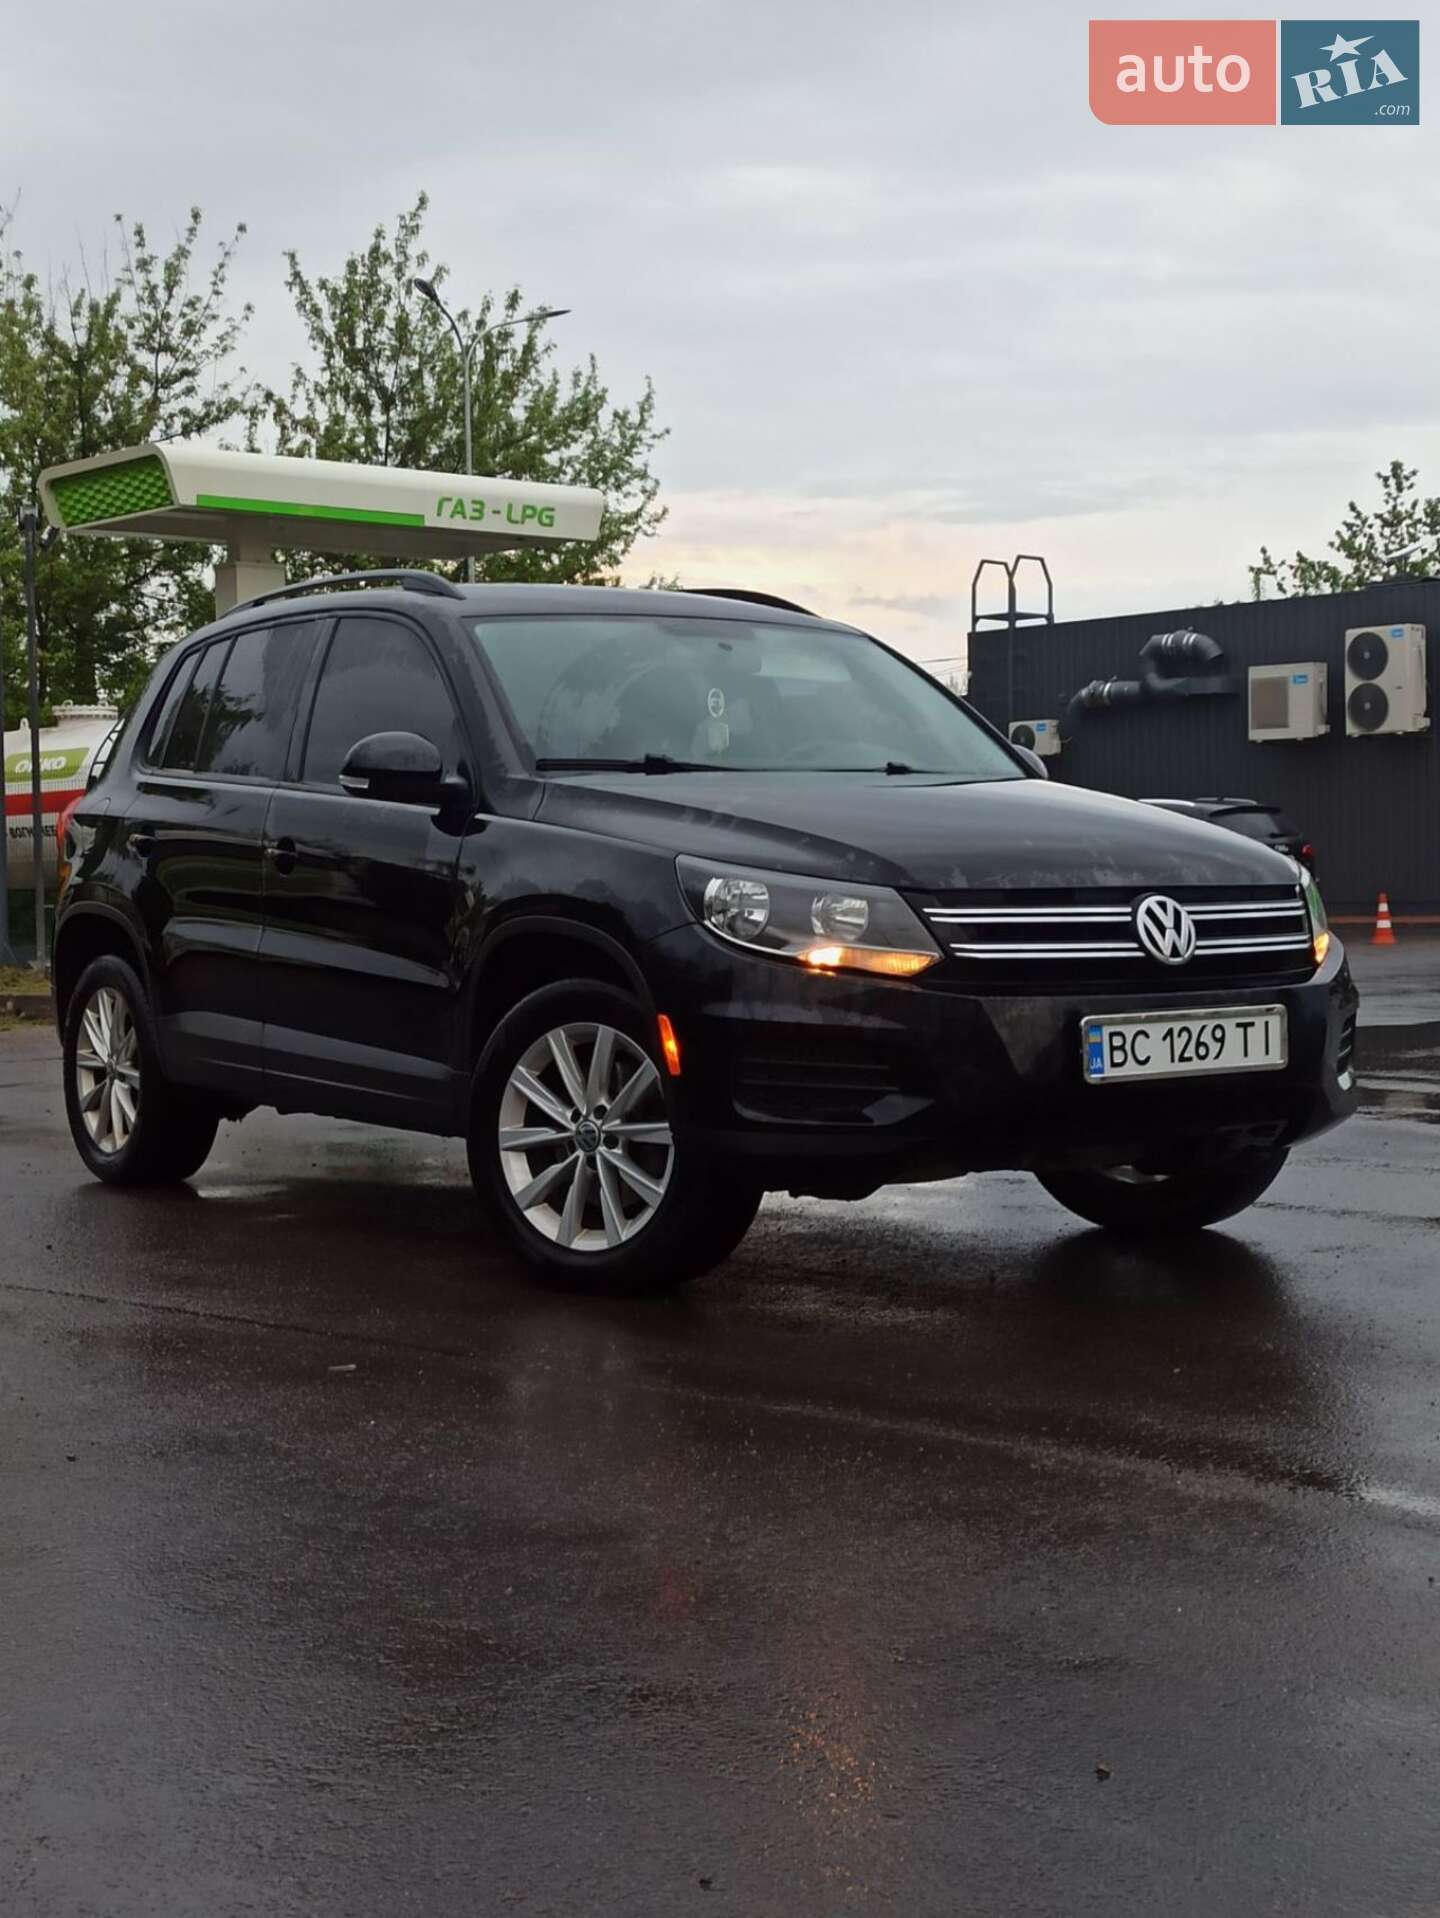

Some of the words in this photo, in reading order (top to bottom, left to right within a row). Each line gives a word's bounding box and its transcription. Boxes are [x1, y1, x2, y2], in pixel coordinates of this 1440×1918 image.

[1108, 1028, 1151, 1069] BC
[1161, 1023, 1226, 1063] 1269
[1235, 1020, 1270, 1058] TI
